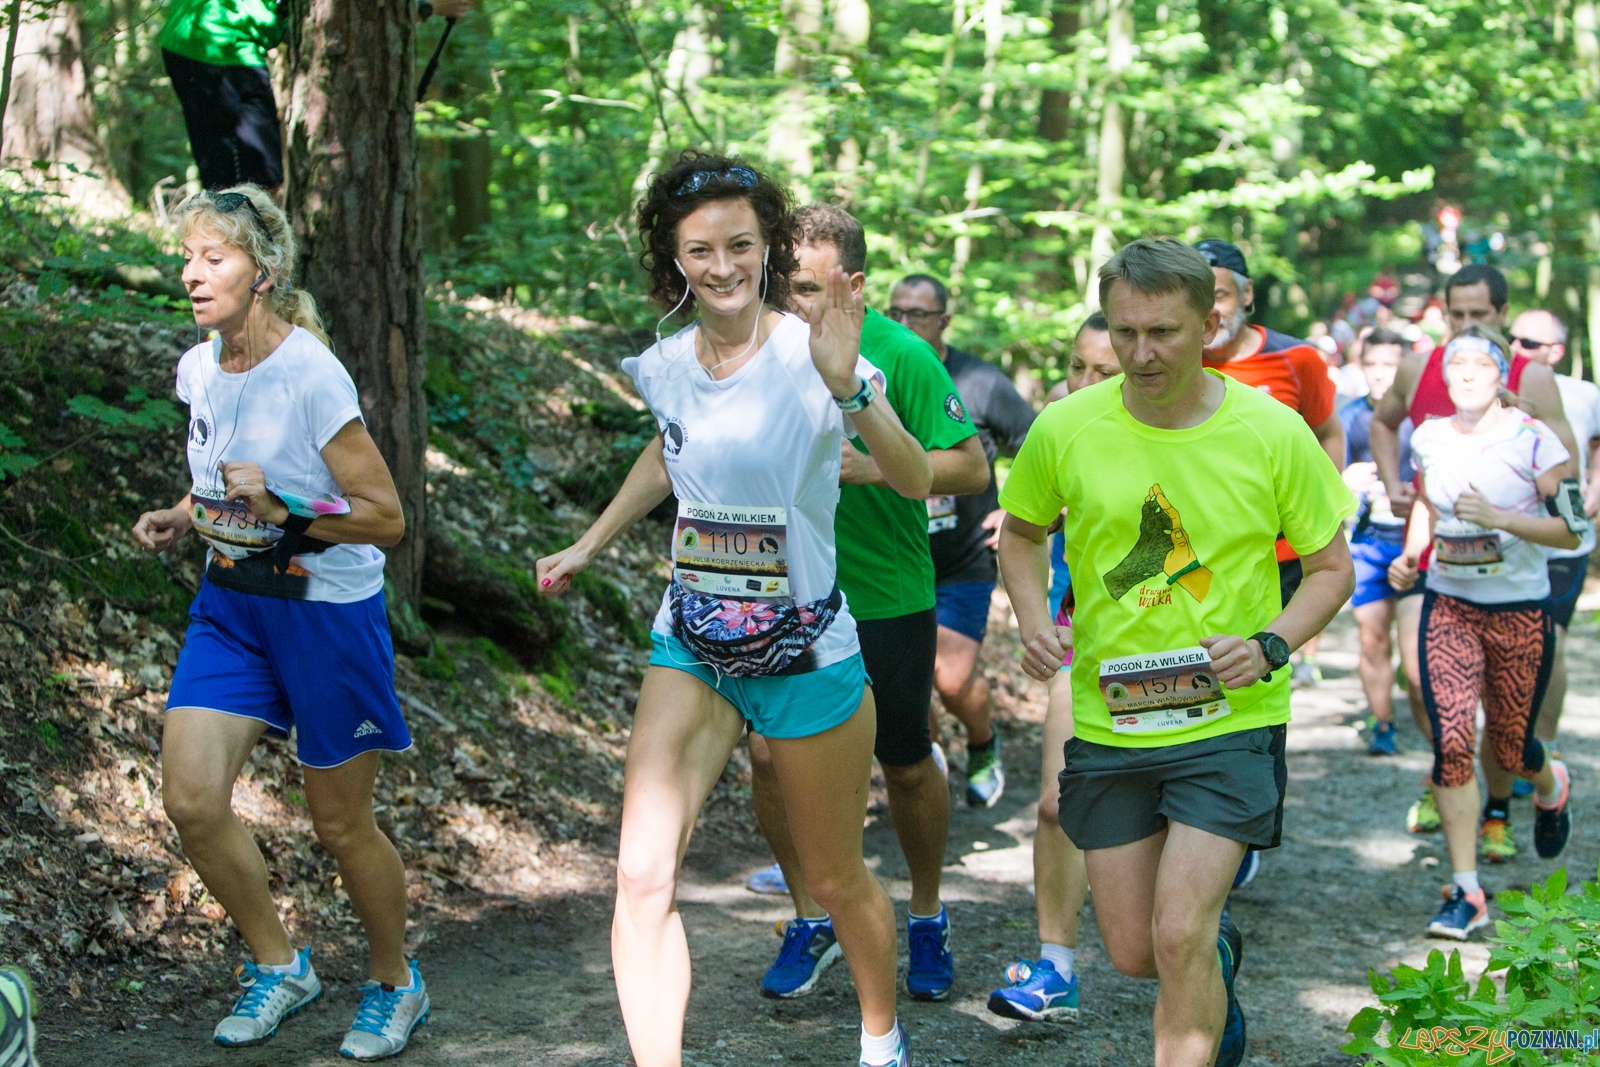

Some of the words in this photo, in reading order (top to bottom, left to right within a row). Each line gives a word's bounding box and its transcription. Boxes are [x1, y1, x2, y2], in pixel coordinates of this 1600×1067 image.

[212, 506, 248, 530] 273
[687, 507, 715, 520] POGOŃ
[717, 512, 730, 521] ZA
[731, 513, 777, 523] WILKIEM
[708, 529, 748, 555] 110
[711, 557, 766, 567] KOBRZENIECKA
[1108, 659, 1143, 673] POGOŃ
[1144, 659, 1159, 669] ZA
[1159, 652, 1205, 667] WILKIEM
[1136, 674, 1179, 697] 157
[1127, 700, 1155, 708] MARCIN
[1157, 719, 1184, 727] LUVENA
[353, 727, 383, 738] adidas
